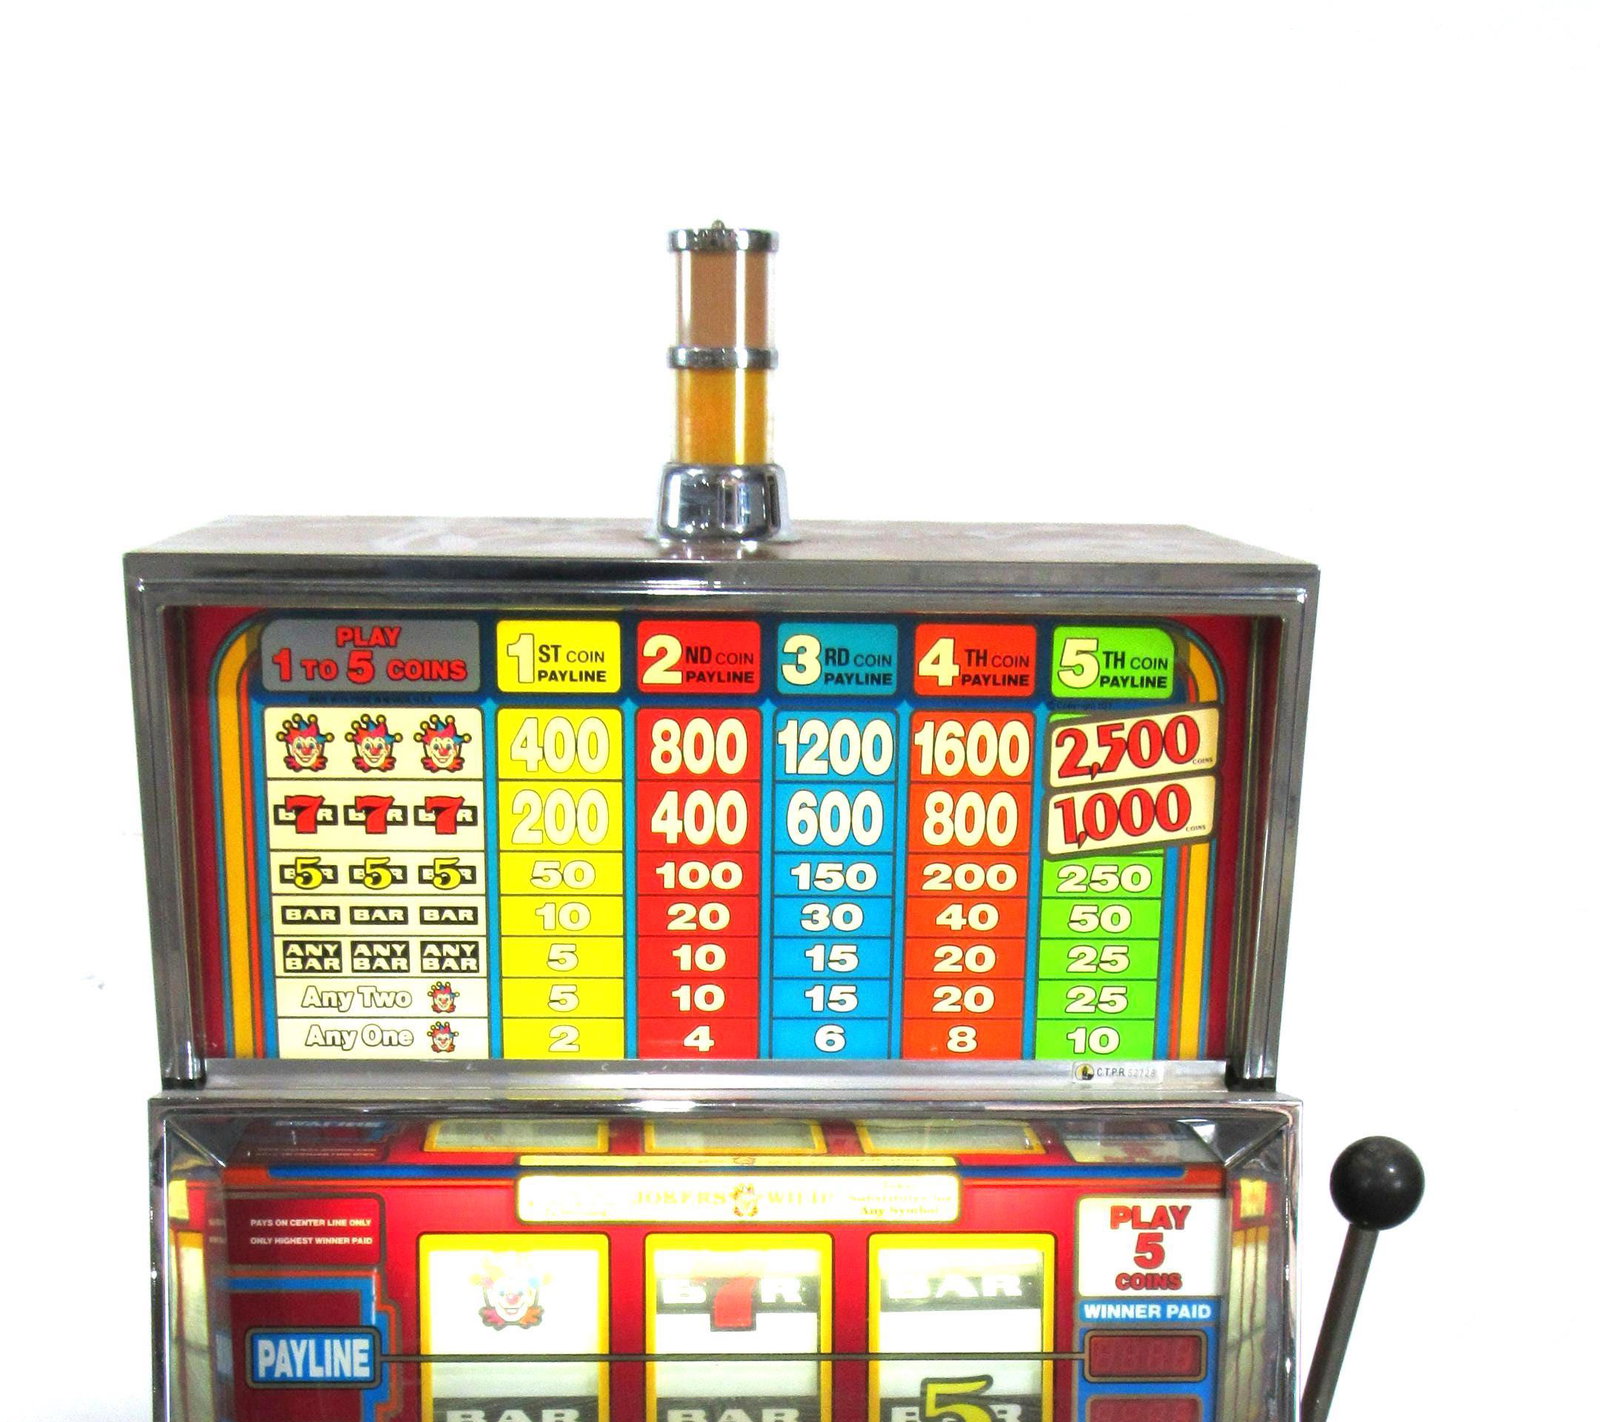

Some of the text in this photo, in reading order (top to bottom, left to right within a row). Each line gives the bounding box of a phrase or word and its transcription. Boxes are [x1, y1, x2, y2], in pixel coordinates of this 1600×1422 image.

[335, 625, 401, 647] PLAY
[272, 648, 468, 684] 1 TO 5 COINS
[566, 650, 605, 664] COIN
[715, 651, 754, 665] COIN
[853, 652, 893, 668] COIN
[990, 653, 1030, 669] COIN
[1129, 655, 1168, 671] COIN
[537, 669, 607, 683] PAYLINE
[685, 670, 755, 684] PAYLINE
[824, 673, 893, 687] PAYLINE
[961, 674, 1031, 688] PAYLINE
[1099, 675, 1168, 689] PAYLINE
[510, 716, 609, 773] 400
[650, 717, 748, 775] 800
[777, 718, 895, 776] 1200
[914, 719, 1031, 777] 1600
[1055, 714, 1200, 780] 2,500
[284, 795, 325, 835] 7
[354, 795, 395, 835] 7
[424, 795, 465, 835] 7
[512, 788, 609, 846] 200
[650, 789, 748, 846] 400
[786, 789, 884, 847] 600
[922, 790, 1018, 847] 800
[1053, 783, 1192, 849] 1,000
[294, 857, 323, 890] 5
[363, 857, 392, 890] 5
[432, 857, 462, 890] 5
[530, 860, 596, 890] 50
[655, 861, 744, 890] 100
[790, 863, 878, 892] 150
[921, 863, 1018, 893] 200
[1056, 864, 1153, 894] 250
[285, 908, 337, 921] BAR
[353, 908, 405, 921] BAR
[423, 909, 474, 922] BAR
[534, 902, 591, 931] 10
[666, 902, 730, 931] 20
[800, 903, 864, 932] 30
[935, 903, 1000, 932] 40
[1068, 904, 1132, 934] 50
[285, 943, 340, 957] ANY
[285, 957, 341, 971] BAR
[352, 957, 409, 971] BAR
[353, 943, 408, 957] ANY
[422, 943, 477, 957] ANY
[422, 957, 478, 971] BAR
[546, 942, 579, 972] 5
[671, 943, 727, 972] 10
[804, 943, 859, 973] 15
[932, 944, 997, 973] 20
[1067, 944, 1131, 974] 25
[301, 985, 412, 1012] Any Two
[548, 984, 580, 1012] 5
[671, 983, 725, 1012] 10
[804, 984, 859, 1014] 15
[931, 985, 996, 1014] 20
[1064, 985, 1130, 1014] 25
[305, 1024, 414, 1051] Any One
[548, 1025, 580, 1053] 2
[683, 1025, 715, 1052] 4
[813, 1024, 846, 1053] 6
[945, 1025, 978, 1054] 8
[1066, 1026, 1121, 1055] 10
[250, 1218, 371, 1227] PAYS ON CENTER LINE ONLY
[1110, 1205, 1191, 1229] PLAY
[250, 1236, 373, 1245] ONLY HIGHEST WINNER PAID
[1134, 1232, 1165, 1269] 5
[886, 1274, 1023, 1300] BAR
[1115, 1272, 1183, 1291] COINS
[1083, 1303, 1212, 1319] WINNER PAID
[257, 1338, 371, 1378] PAYLINE
